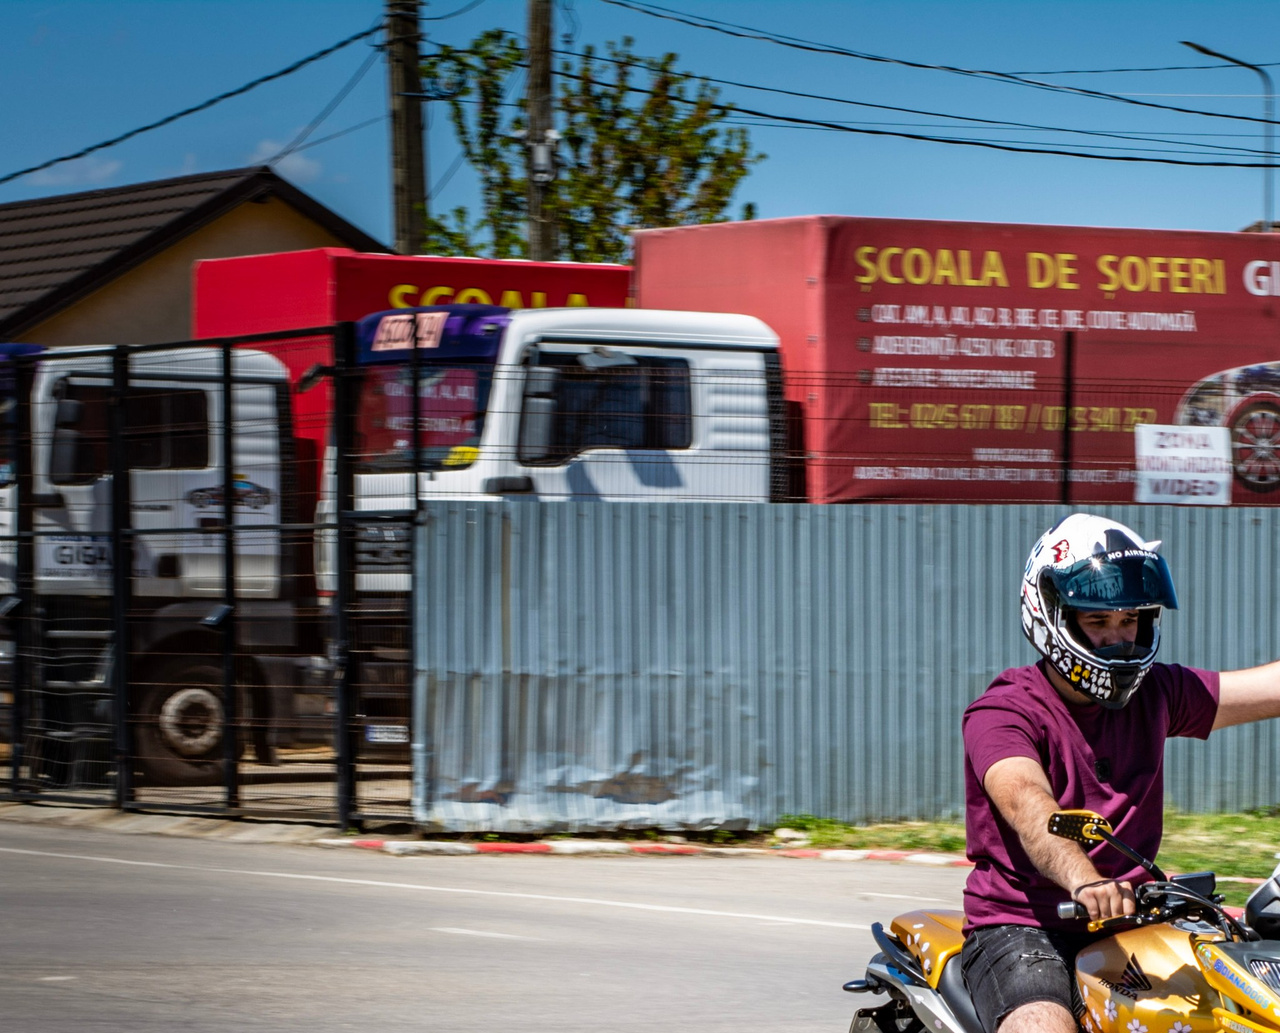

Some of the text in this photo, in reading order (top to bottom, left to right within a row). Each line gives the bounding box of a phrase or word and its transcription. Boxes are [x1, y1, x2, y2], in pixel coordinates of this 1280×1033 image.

[1026, 251, 1081, 290] DE
[1153, 431, 1215, 450] ZONA
[1149, 478, 1220, 496] VIDEO
[1107, 549, 1159, 561] NO AIRBAGS
[1098, 978, 1138, 1001] HONDA
